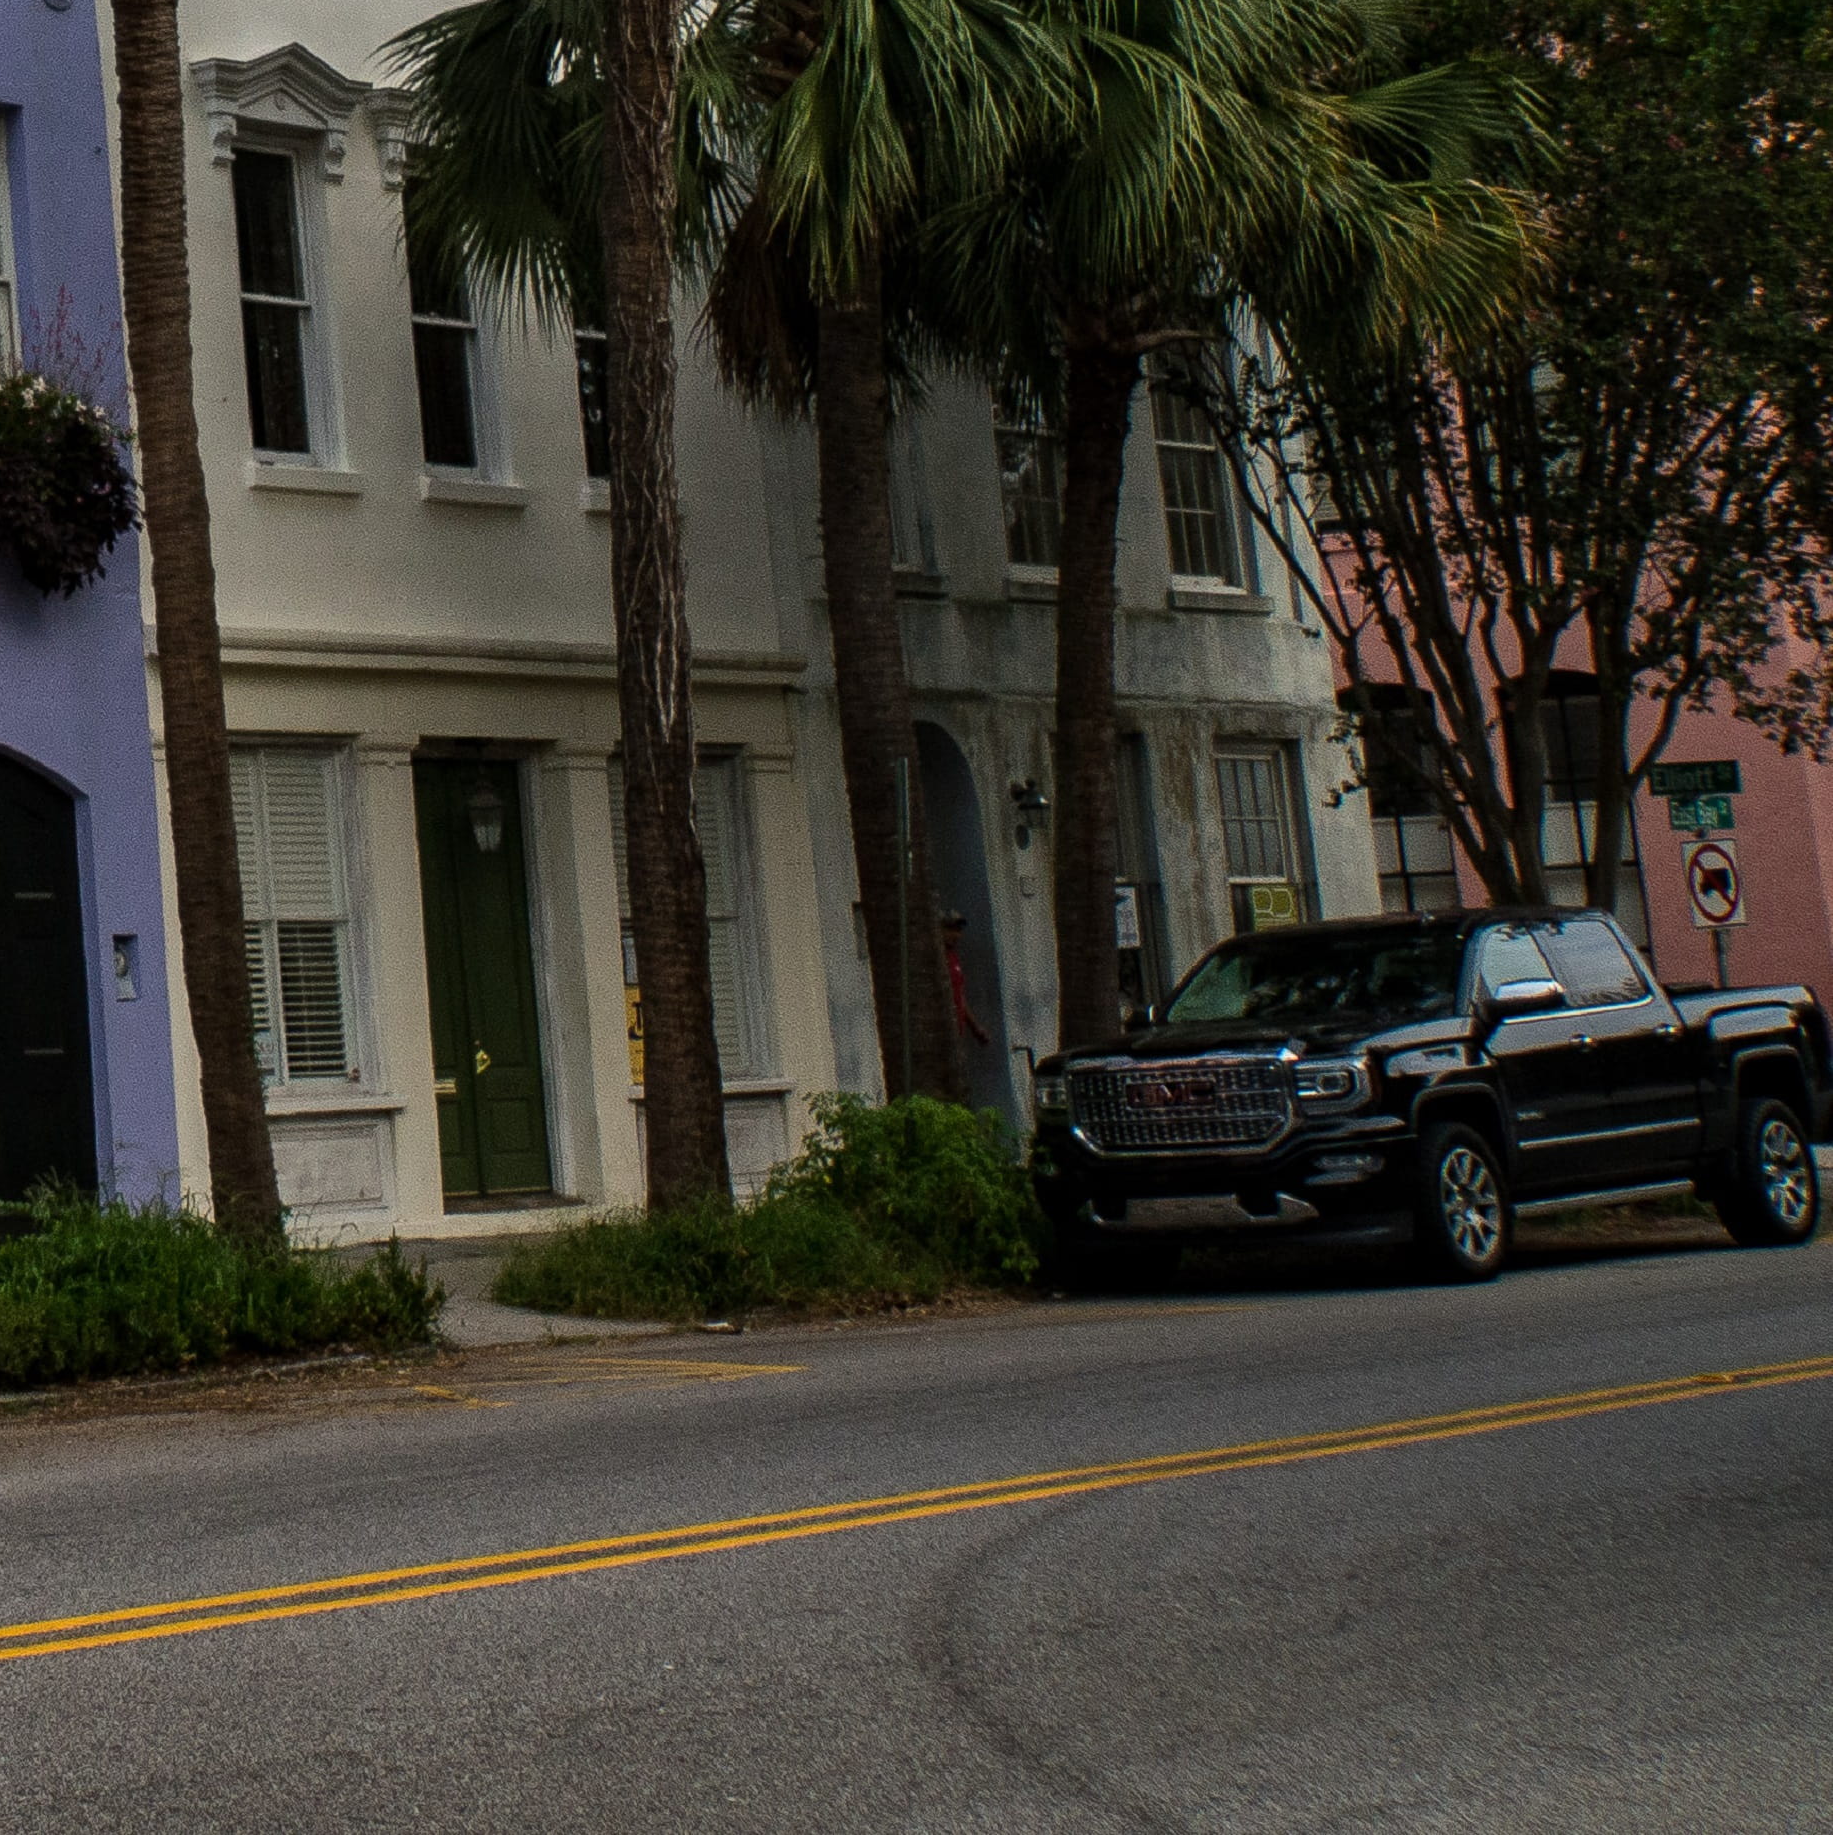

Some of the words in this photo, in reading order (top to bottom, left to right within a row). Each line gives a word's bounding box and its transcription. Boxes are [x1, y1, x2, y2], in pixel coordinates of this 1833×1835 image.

[1653, 766, 1716, 790] Elliott
[1697, 800, 1719, 827] Bay
[1126, 1082, 1214, 1105] GMC
